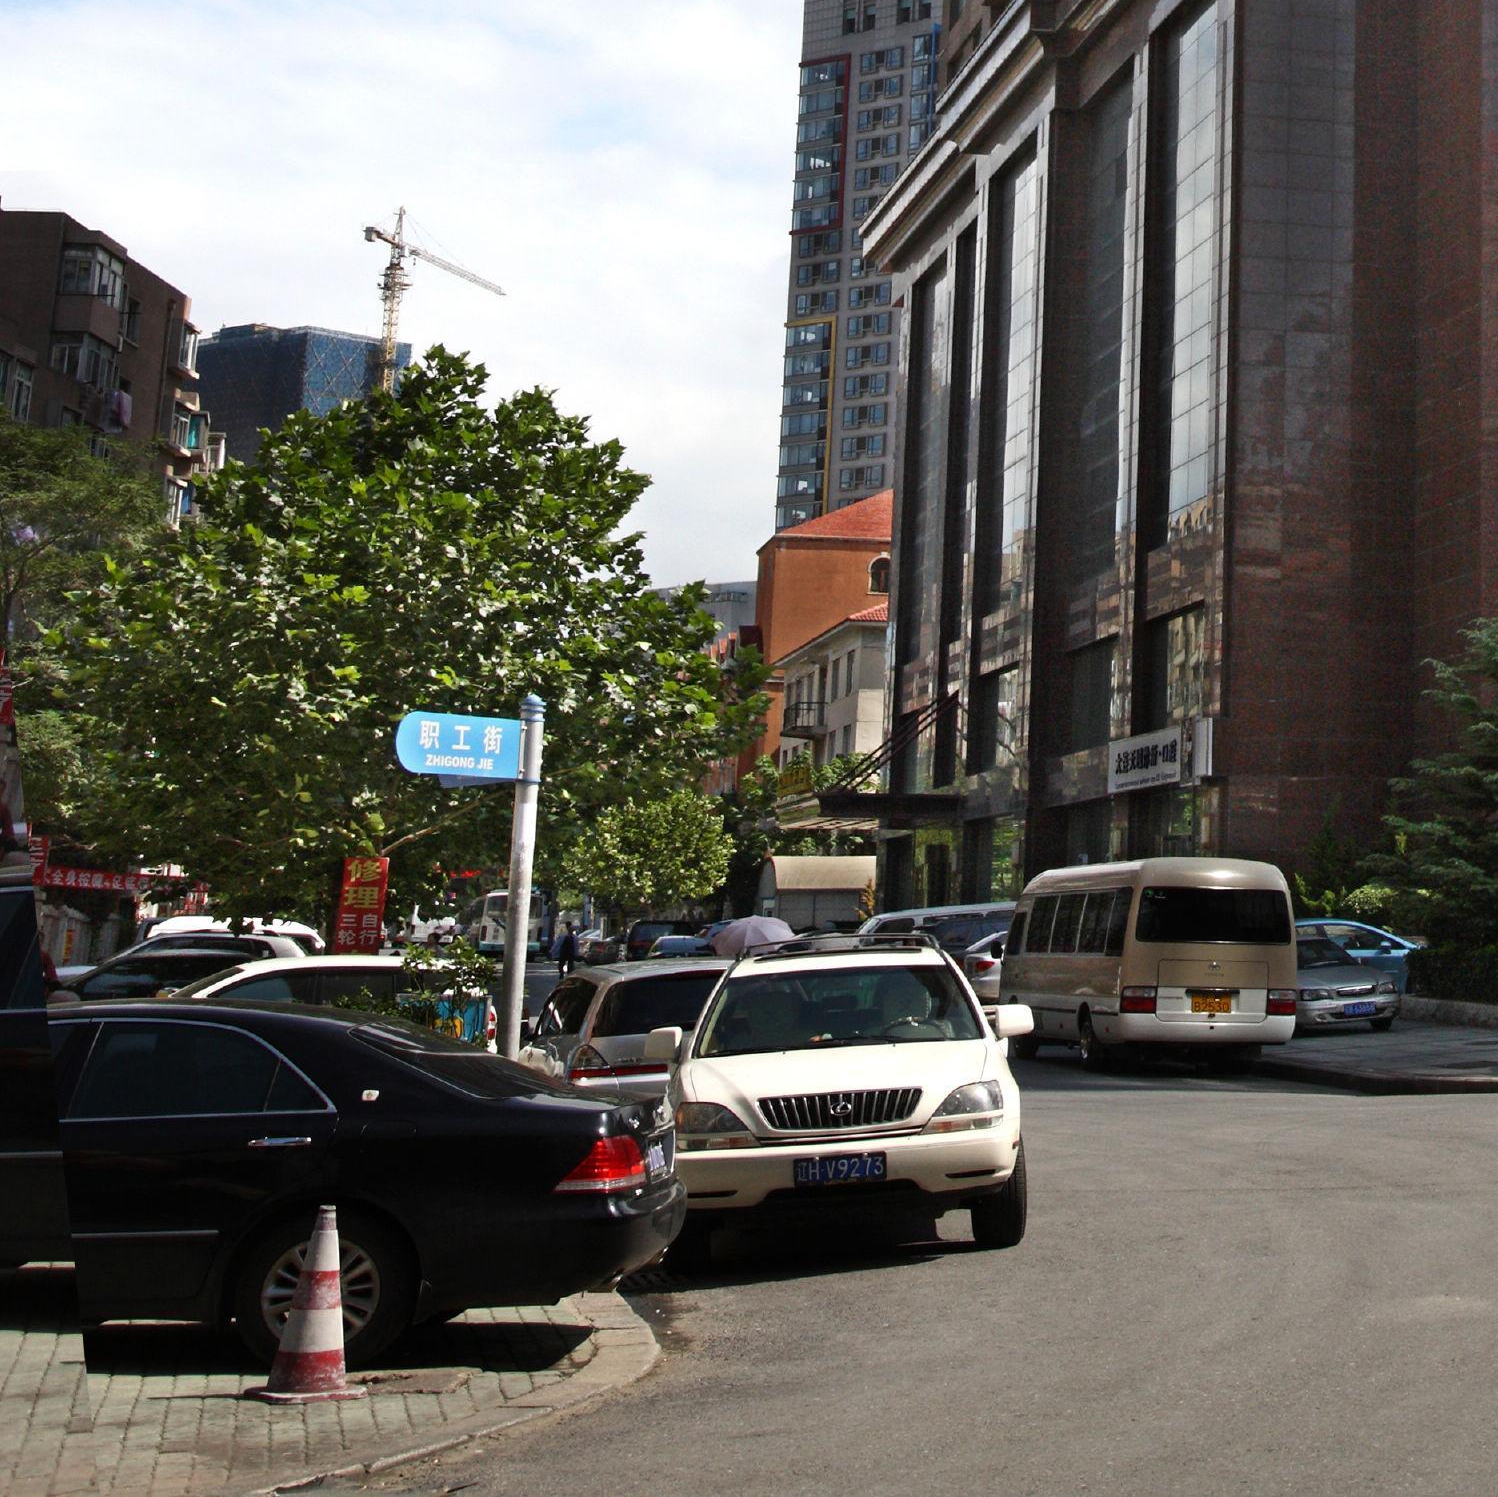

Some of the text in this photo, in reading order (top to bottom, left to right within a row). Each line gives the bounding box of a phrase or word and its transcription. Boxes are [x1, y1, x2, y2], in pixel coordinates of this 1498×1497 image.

[419, 720, 503, 754] 职工街
[425, 754, 494, 770] ZHIGONG JIE
[347, 860, 382, 909] 修理
